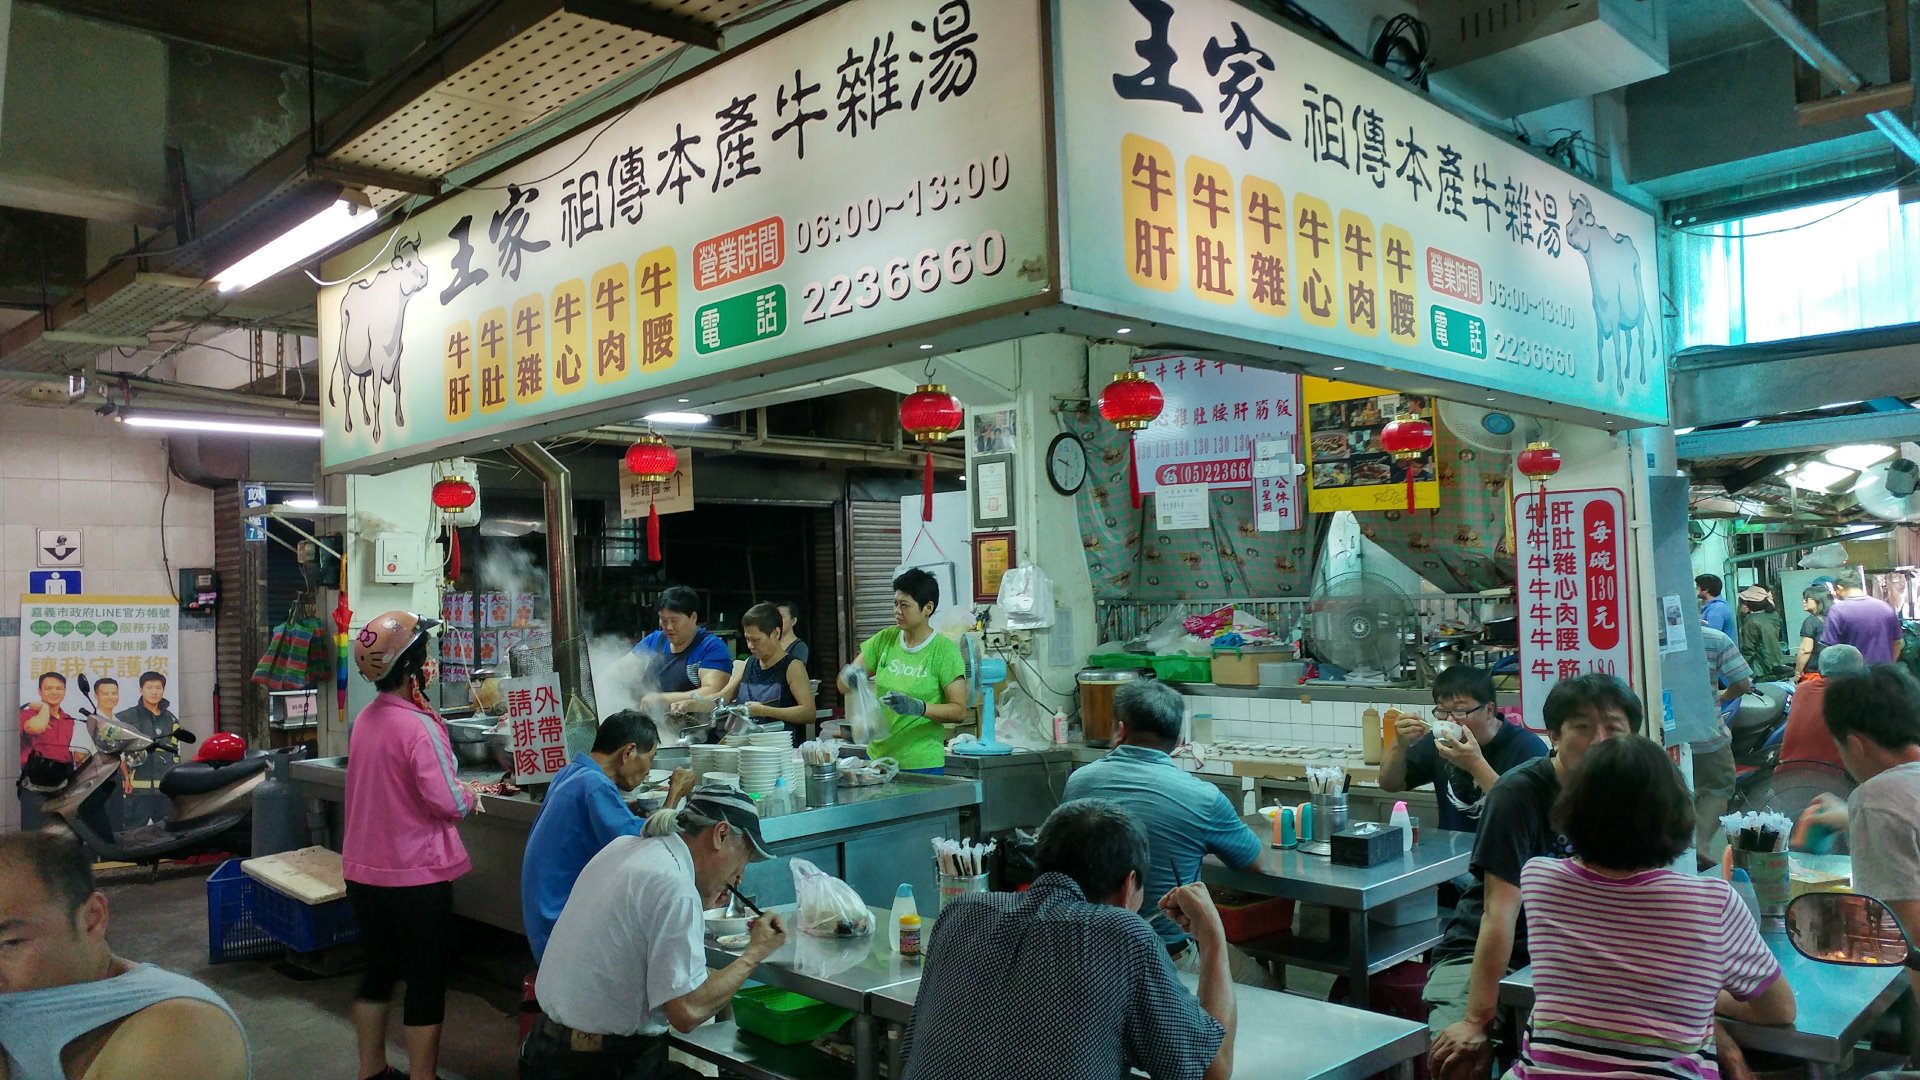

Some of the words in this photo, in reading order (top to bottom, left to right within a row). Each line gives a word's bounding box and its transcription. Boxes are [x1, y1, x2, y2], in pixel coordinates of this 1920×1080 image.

[440, 183, 551, 306] 王家
[560, 0, 979, 249] 祖傳本產牛雜湯
[1113, 0, 1291, 151] 王家
[1303, 83, 1562, 259] 祖傳本產牛雜湯
[699, 222, 779, 287] 營業時間
[1132, 152, 1175, 281] 牛肝
[1193, 173, 1234, 296] 牛肚
[1248, 191, 1286, 306] 牛雜
[803, 229, 1006, 325] 2236660
[1299, 208, 1333, 318] 牛心
[1345, 224, 1375, 329] 牛肉
[1386, 237, 1416, 338] 牛腰
[1430, 251, 1480, 301] 營業時間
[516, 306, 542, 397] 牛雜
[554, 293, 582, 386] 牛心
[595, 278, 625, 377] 牛肉
[640, 262, 673, 366] 牛腰
[700, 290, 777, 349] 電話
[1434, 310, 1483, 355] 電話
[1495, 331, 1576, 378] 2236660
[448, 331, 471, 416] 牛肝
[481, 319, 505, 408] 牛肚
[1175, 440, 1189, 457] 130
[1194, 437, 1209, 456] 130
[1214, 436, 1230, 454] 130
[1234, 434, 1250, 453] 130
[1180, 461, 1251, 482] (05)22366
[1275, 476, 1289, 518] 公休日
[888, 659, 928, 677] Sports
[508, 689, 544, 776] 請排隊
[534, 686, 567, 773] 外帶區
